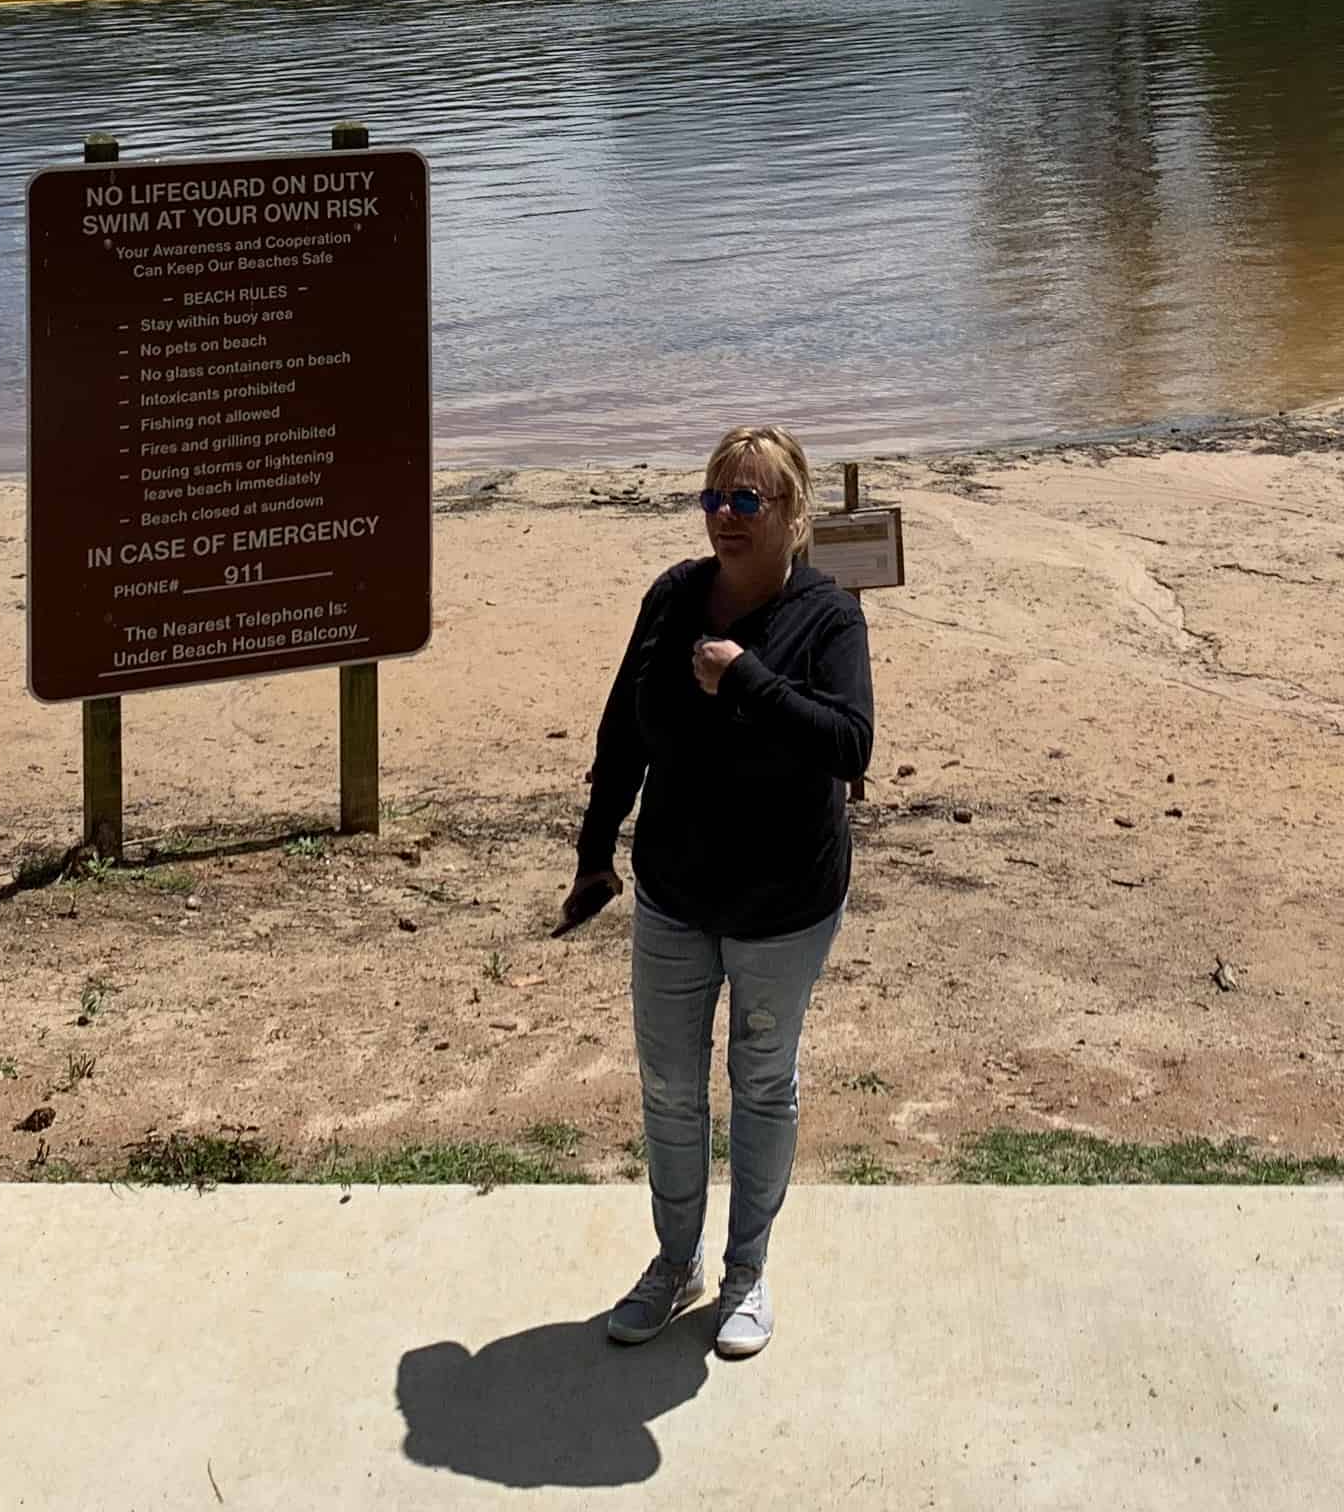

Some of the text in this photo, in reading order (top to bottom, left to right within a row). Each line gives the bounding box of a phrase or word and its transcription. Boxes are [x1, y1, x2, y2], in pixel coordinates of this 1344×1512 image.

[87, 172, 373, 206] NO LIFEGUARD ON DUTY
[83, 198, 378, 234] SWIM AT YOUR OWN RISK
[117, 233, 350, 258] Your Awareness and Cooperation
[134, 252, 332, 277] Can Keep Our Beaches Safe
[184, 286, 287, 305] BEACH RULES
[141, 310, 292, 332] Stay within buoy area
[141, 335, 266, 357] No pets on beach
[141, 352, 350, 381] No glass containers on beach
[141, 380, 295, 406] Intoxicants prohibited
[141, 406, 279, 431] Fishing not allowed
[142, 424, 335, 456] Fires and grilling prohibited
[142, 452, 333, 480] During storms or lightening
[145, 471, 320, 500] leave beach immediately
[142, 497, 323, 526] Beach closed at sundown
[88, 516, 380, 568] IN CASE OF EMERGENCY
[223, 563, 266, 585] 911
[124, 602, 346, 642] The Nearest Telephone Is:
[114, 624, 358, 667] Under Beach House Balcony
